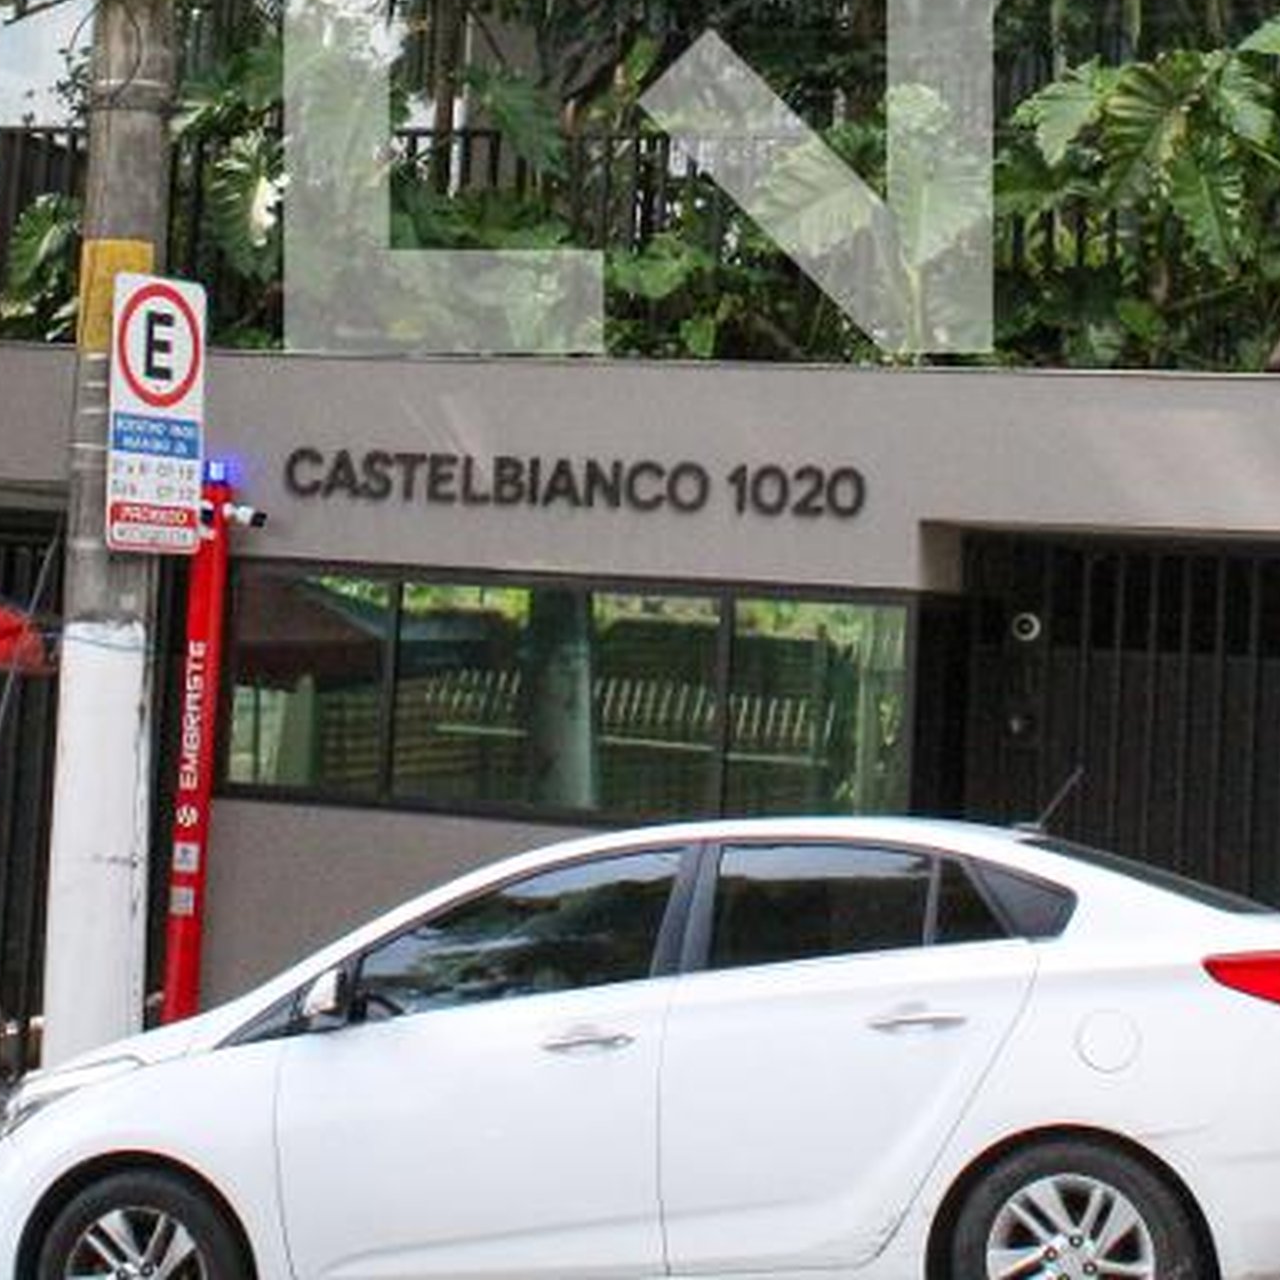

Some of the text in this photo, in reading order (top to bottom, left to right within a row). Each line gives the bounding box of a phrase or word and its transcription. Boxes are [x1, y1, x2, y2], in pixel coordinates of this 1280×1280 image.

[144, 311, 174, 381] E
[283, 447, 867, 519] CASTELBIANCO 1020
